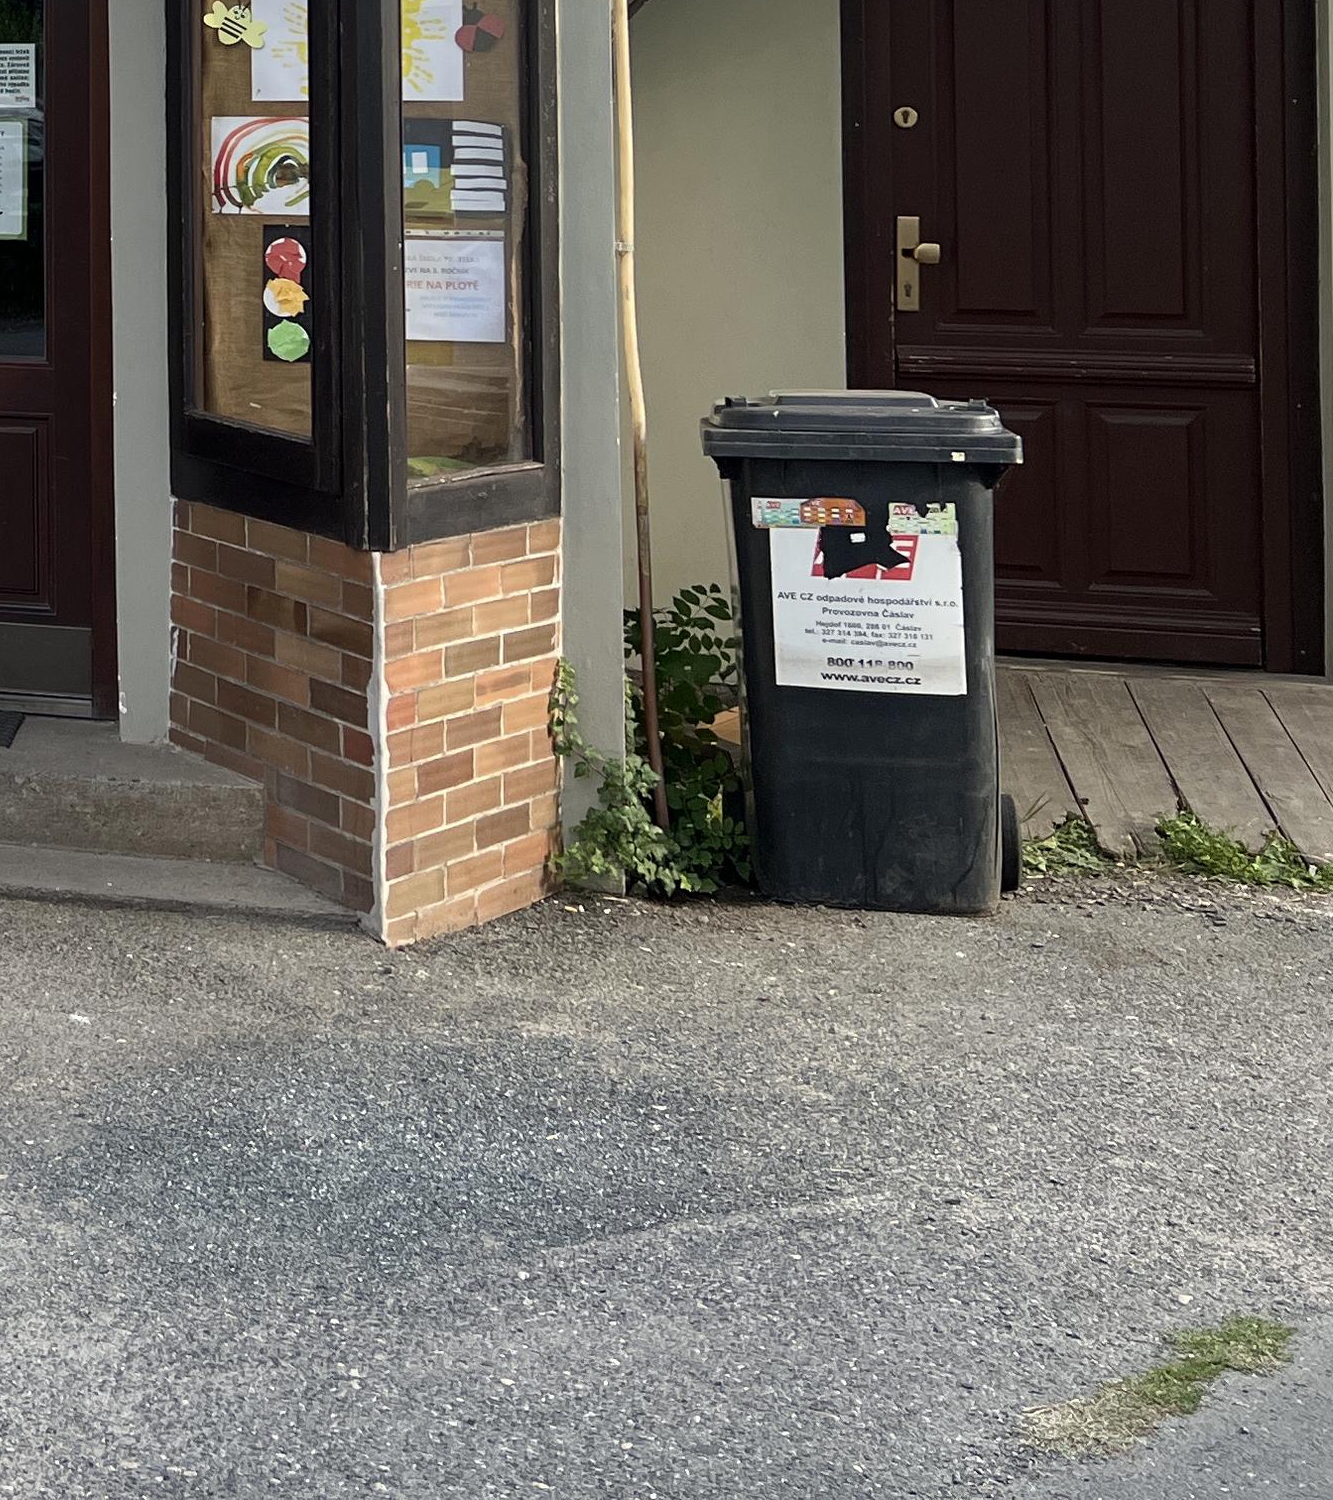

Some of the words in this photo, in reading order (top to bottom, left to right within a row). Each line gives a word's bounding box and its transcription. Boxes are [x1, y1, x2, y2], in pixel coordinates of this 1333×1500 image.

[777, 591, 797, 600] AVE
[800, 592, 813, 601] CZ
[816, 594, 865, 604] odpadové
[867, 596, 932, 607] hospodářství
[821, 606, 879, 617] Provozovna
[882, 608, 915, 619] Čáslav
[827, 657, 853, 668] 800
[821, 672, 922, 685] www.avecz.cz
